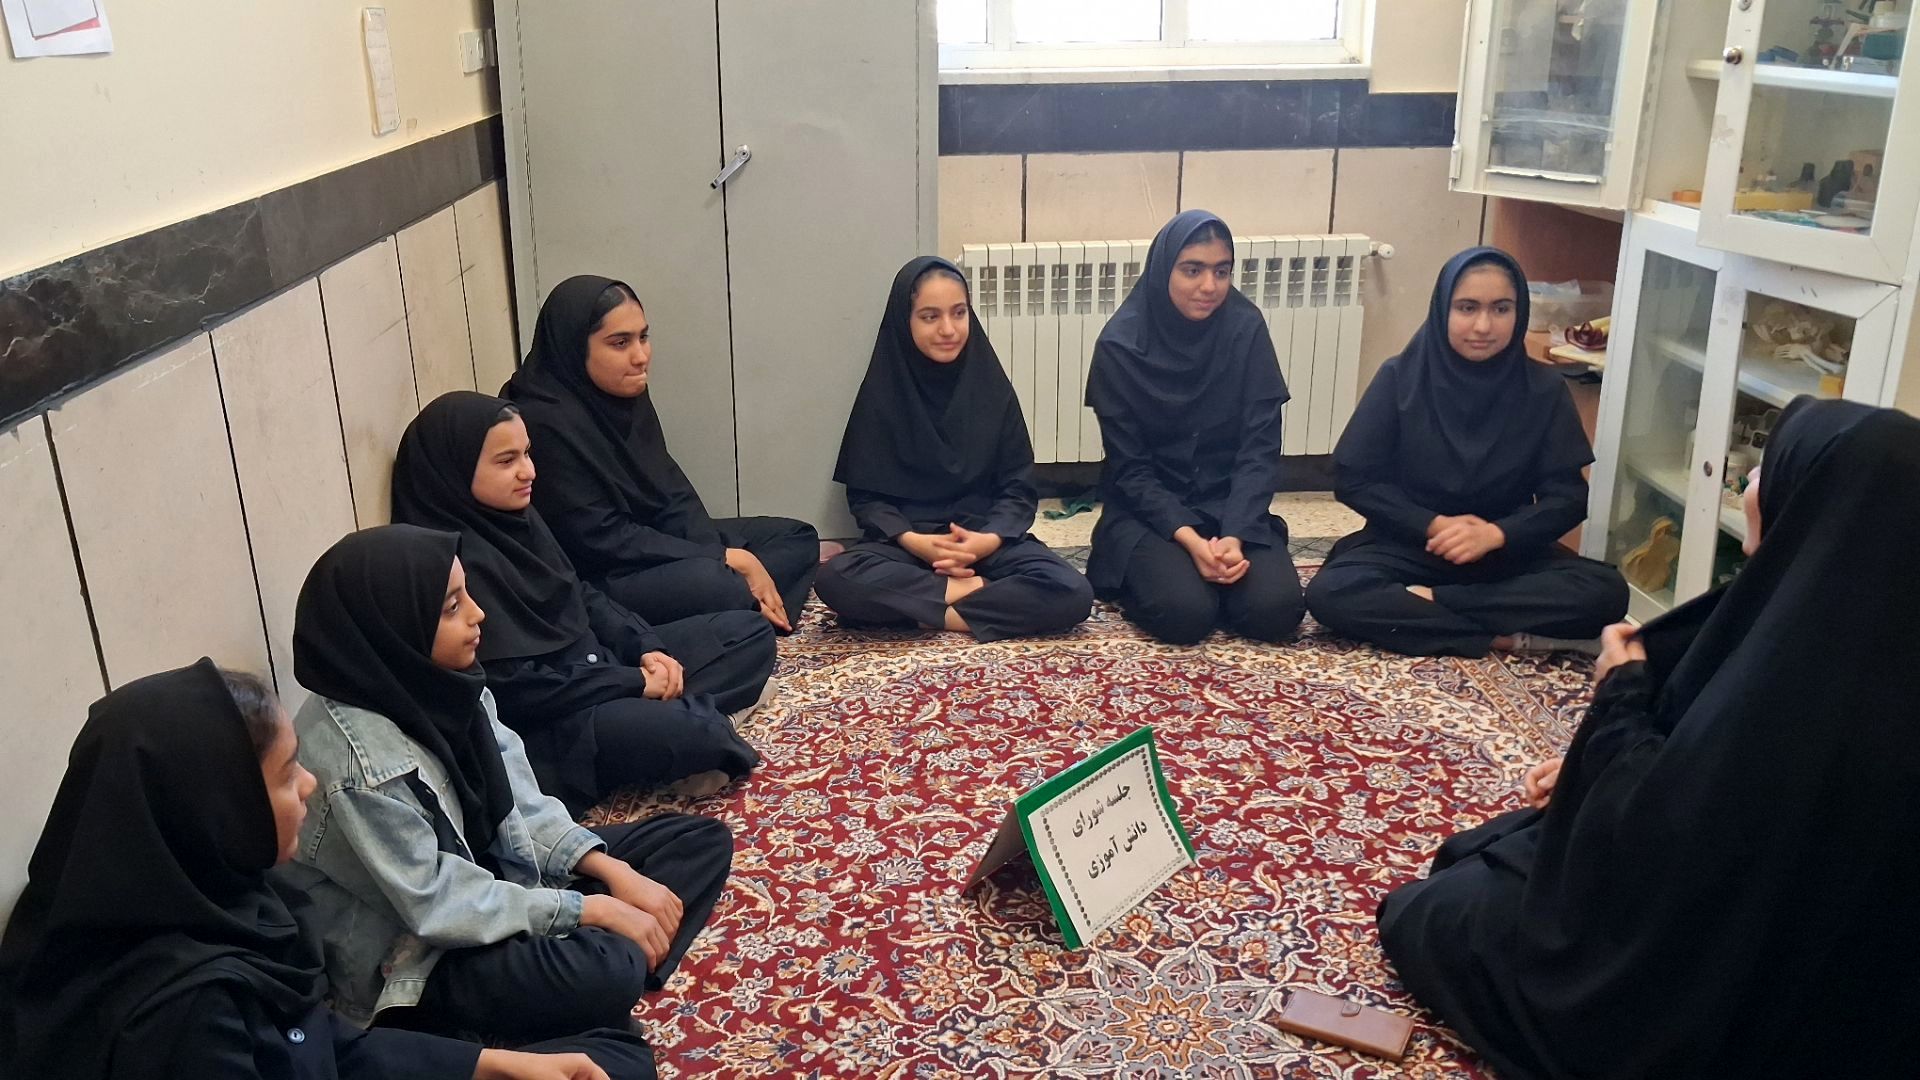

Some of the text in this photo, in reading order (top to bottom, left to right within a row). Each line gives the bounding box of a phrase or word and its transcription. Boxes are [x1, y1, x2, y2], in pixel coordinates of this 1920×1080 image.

[1072, 784, 1131, 838] جلسه شورای
[1088, 820, 1147, 879] دانش آموزی
